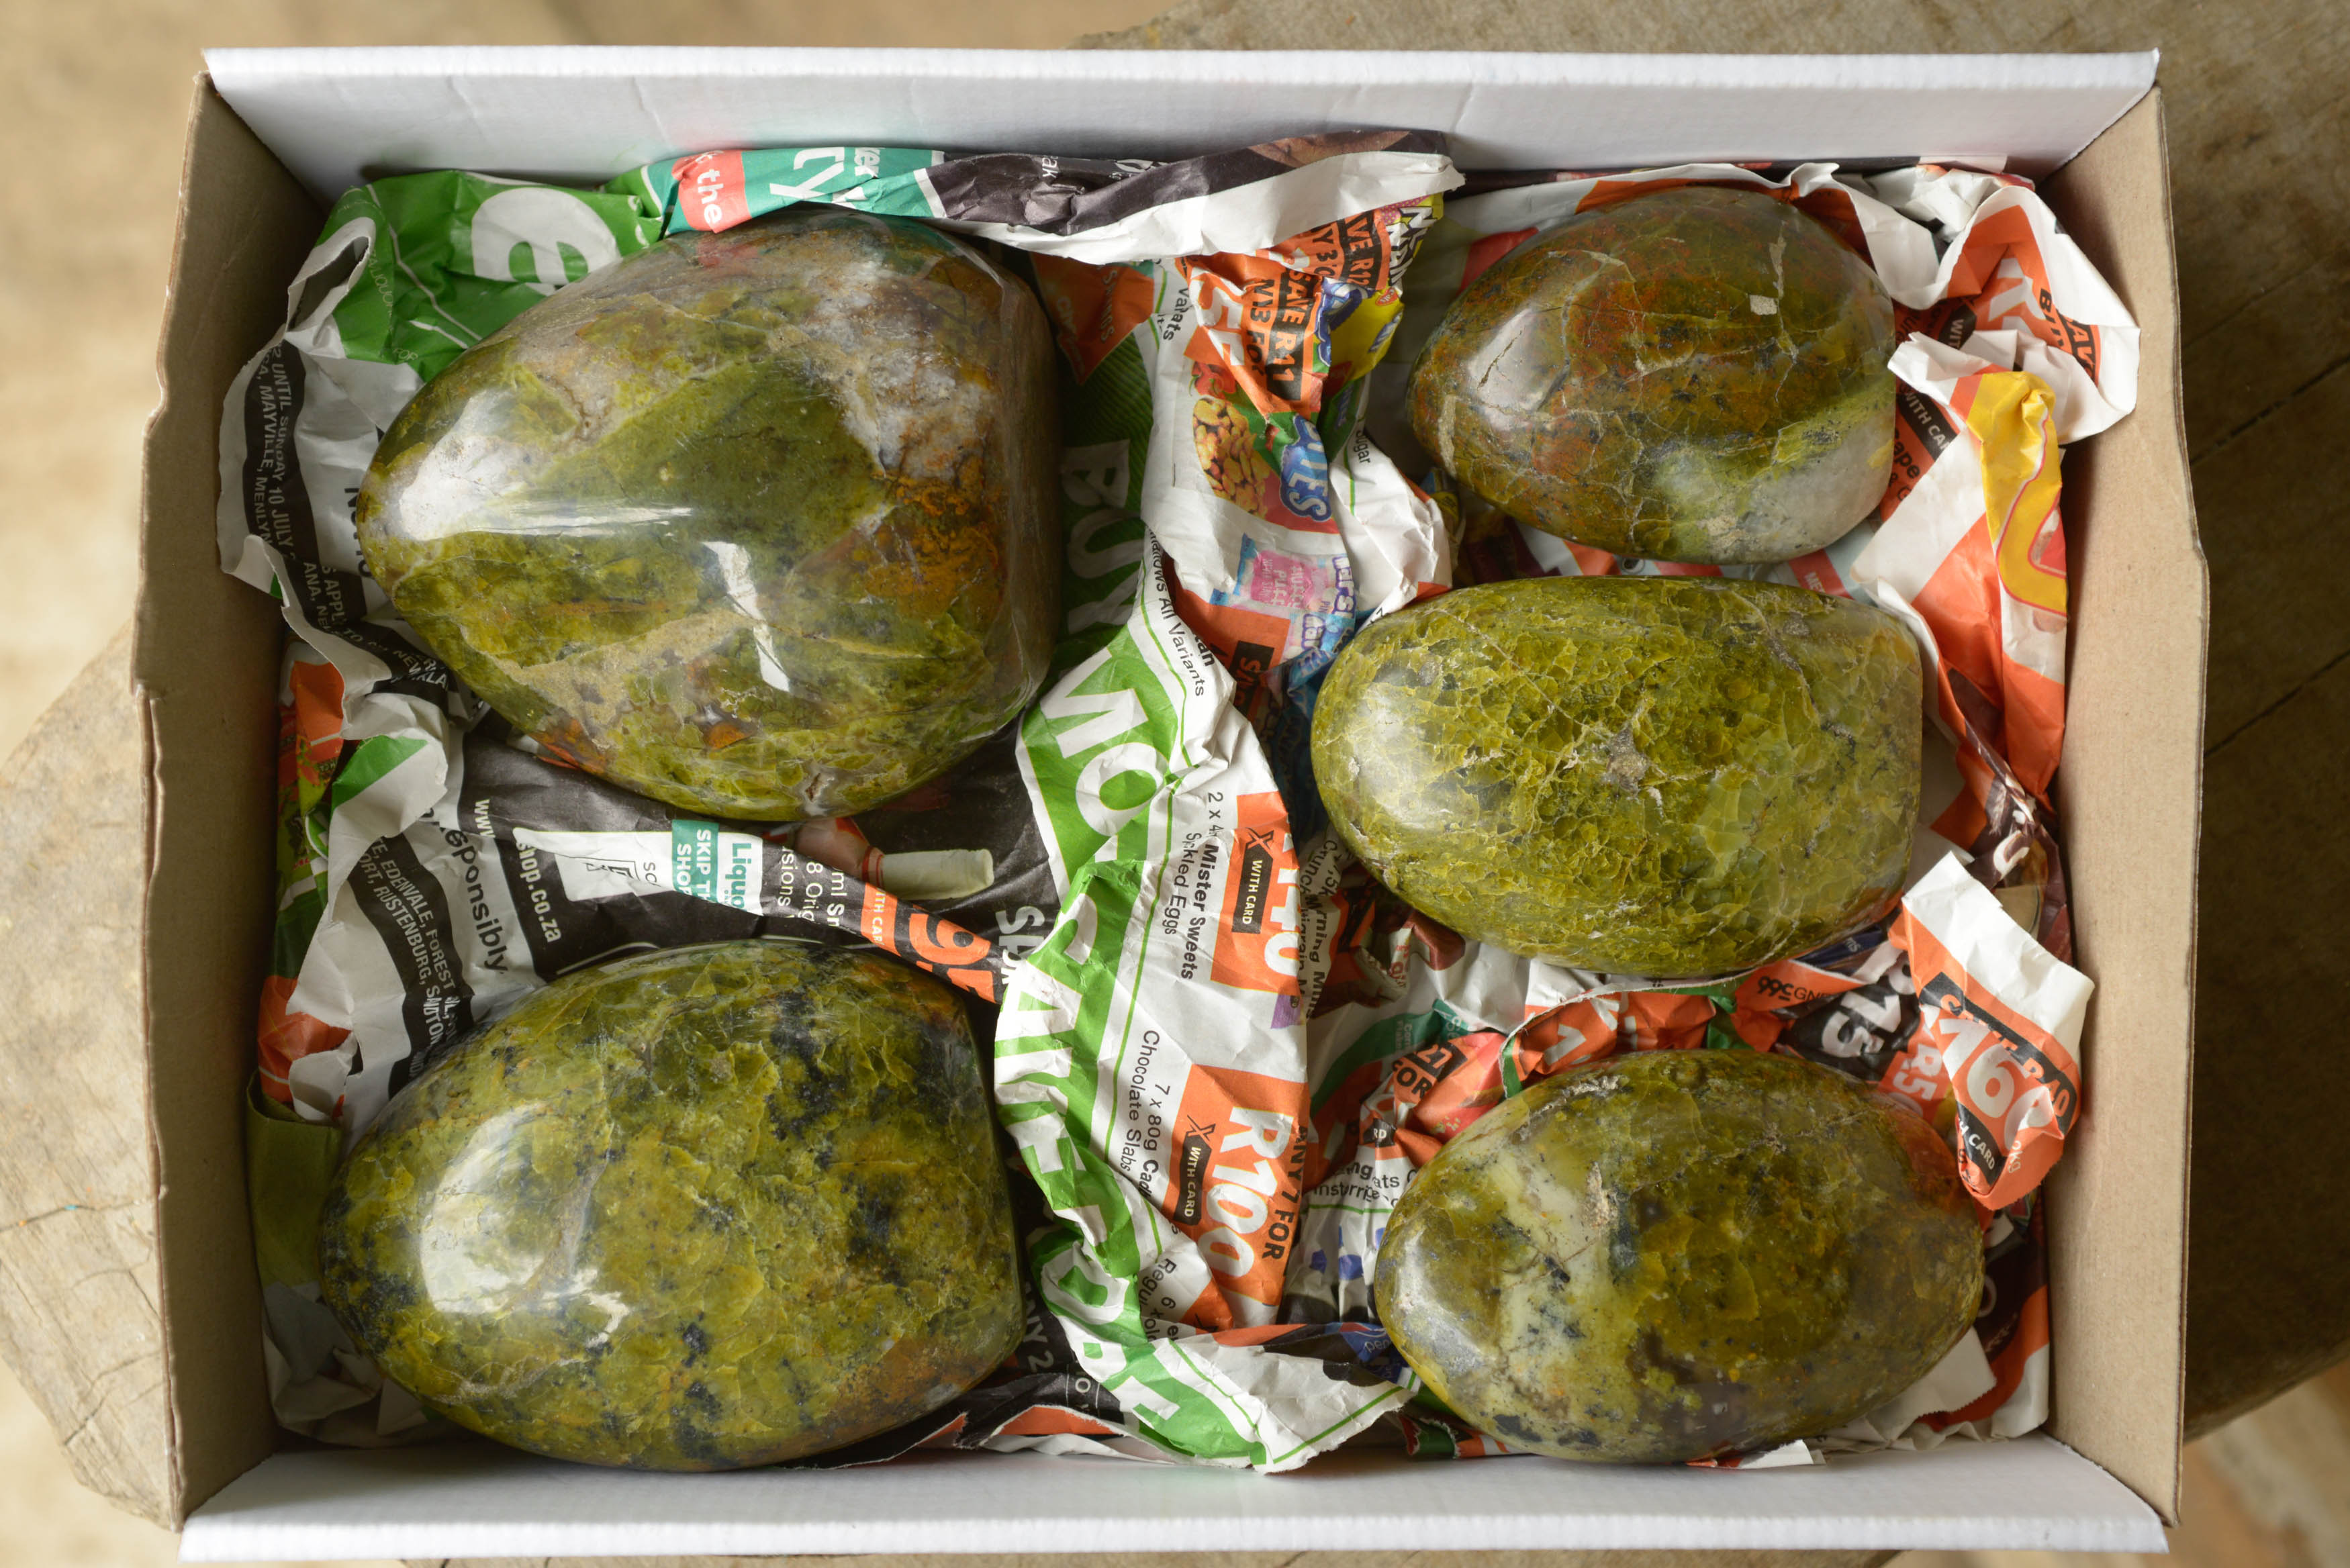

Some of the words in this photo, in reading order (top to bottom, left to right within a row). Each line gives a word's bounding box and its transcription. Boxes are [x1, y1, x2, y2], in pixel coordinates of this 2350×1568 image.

[696, 168, 724, 225] the
[1282, 268, 1311, 326] SAVE
[1272, 332, 1299, 382] R11
[271, 363, 292, 411] UNTIL
[256, 385, 278, 473] MAYVILLE,
[272, 415, 289, 482] SUNDAY
[1893, 428, 1920, 479] ape
[269, 488, 285, 505] 10
[271, 509, 295, 548] JULY
[1158, 597, 1178, 621] All
[1168, 622, 1205, 697] Variants
[1208, 791, 1224, 803] 2
[1209, 809, 1221, 820] x
[696, 828, 712, 875] SKIP
[806, 861, 824, 874] 8
[1192, 844, 1219, 912] Mister
[1248, 859, 1263, 893] WITH
[380, 859, 435, 929] EDENVALE,
[426, 928, 458, 990] FOREST
[1164, 894, 1187, 936] Eggs
[1241, 894, 1257, 925] CARD
[372, 885, 432, 986] RUSTENBURG,
[1180, 917, 1206, 980] Sweets
[1128, 1030, 1160, 1122] Chocolate
[1154, 1083, 1171, 1095] 7
[1149, 1098, 1162, 1108] x
[1122, 1128, 1141, 1172] Slabs
[1143, 1114, 1162, 1151] 80g
[1968, 1133, 1996, 1171] CARD
[1186, 1145, 1202, 1179] WITH
[1184, 1180, 1196, 1218] CARD
[1197, 1105, 1295, 1277] R100
[1280, 1189, 1301, 1204] 7
[1262, 1208, 1296, 1260] FOR
